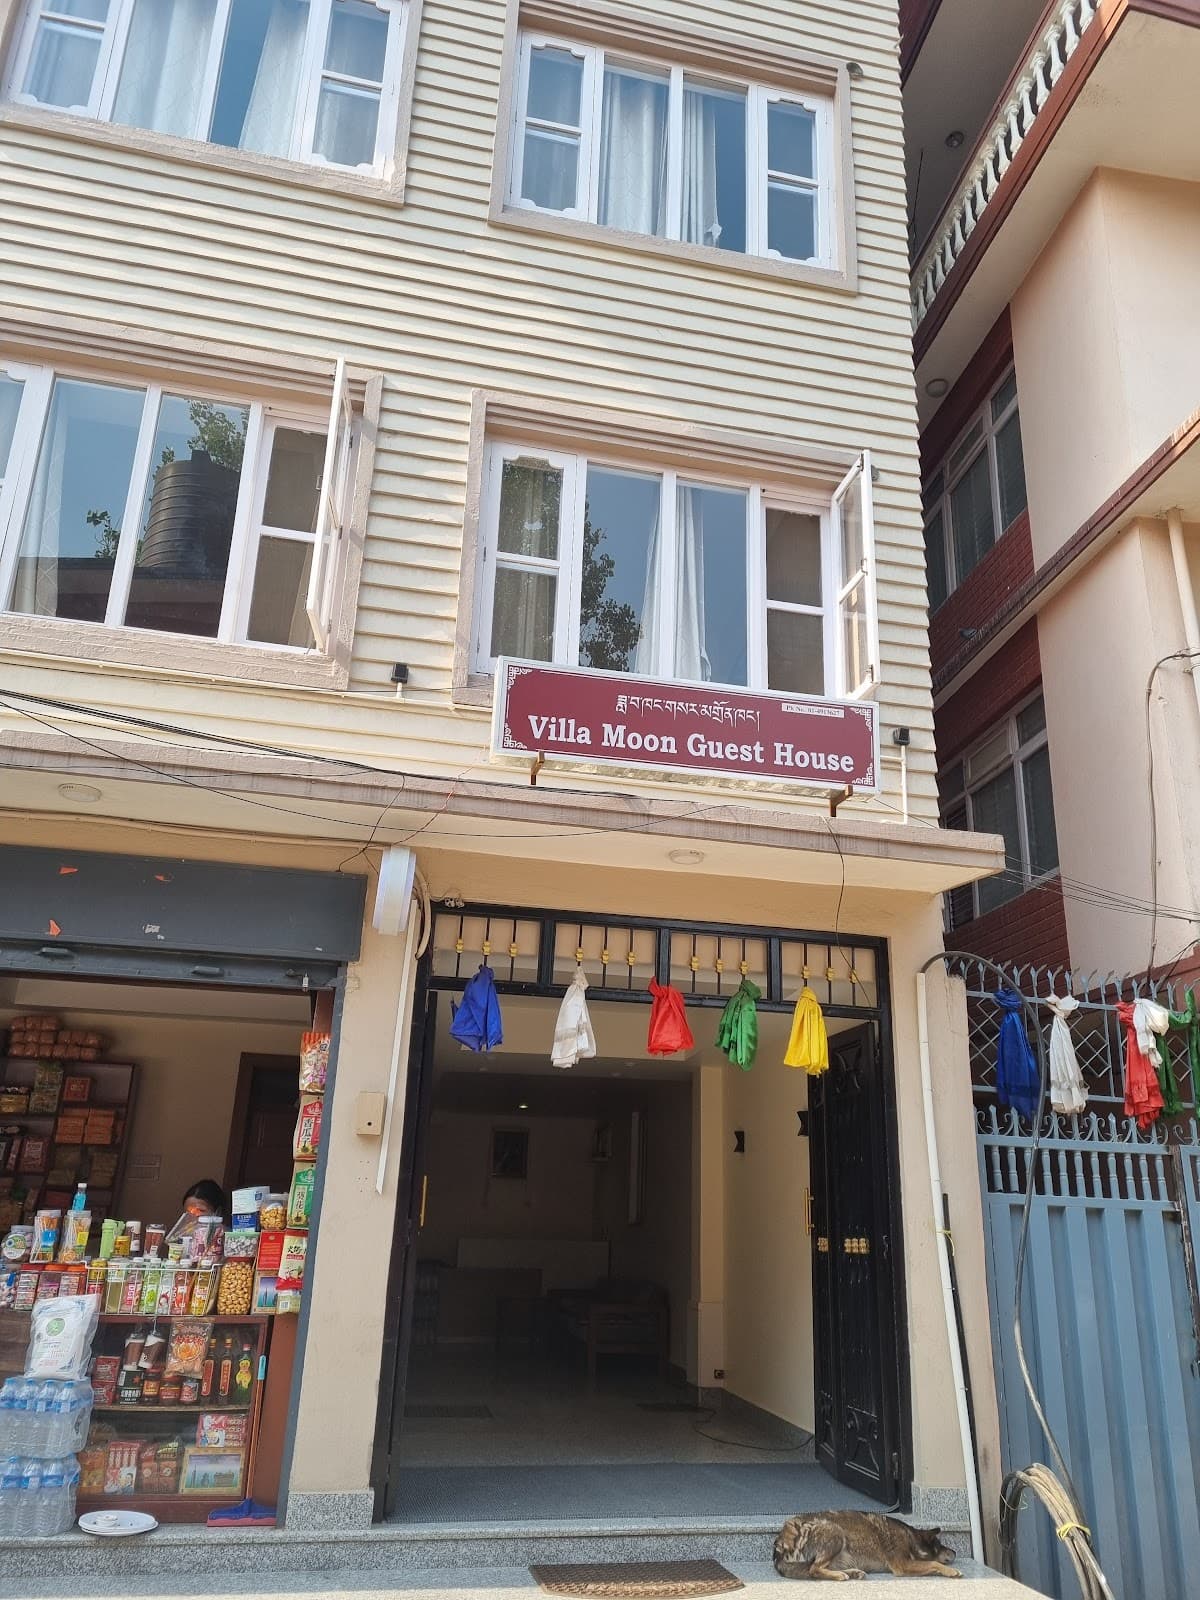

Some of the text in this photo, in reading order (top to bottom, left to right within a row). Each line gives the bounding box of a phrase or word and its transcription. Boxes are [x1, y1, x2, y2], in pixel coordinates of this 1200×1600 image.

[528, 714, 854, 772] Villa Moon Guest House
